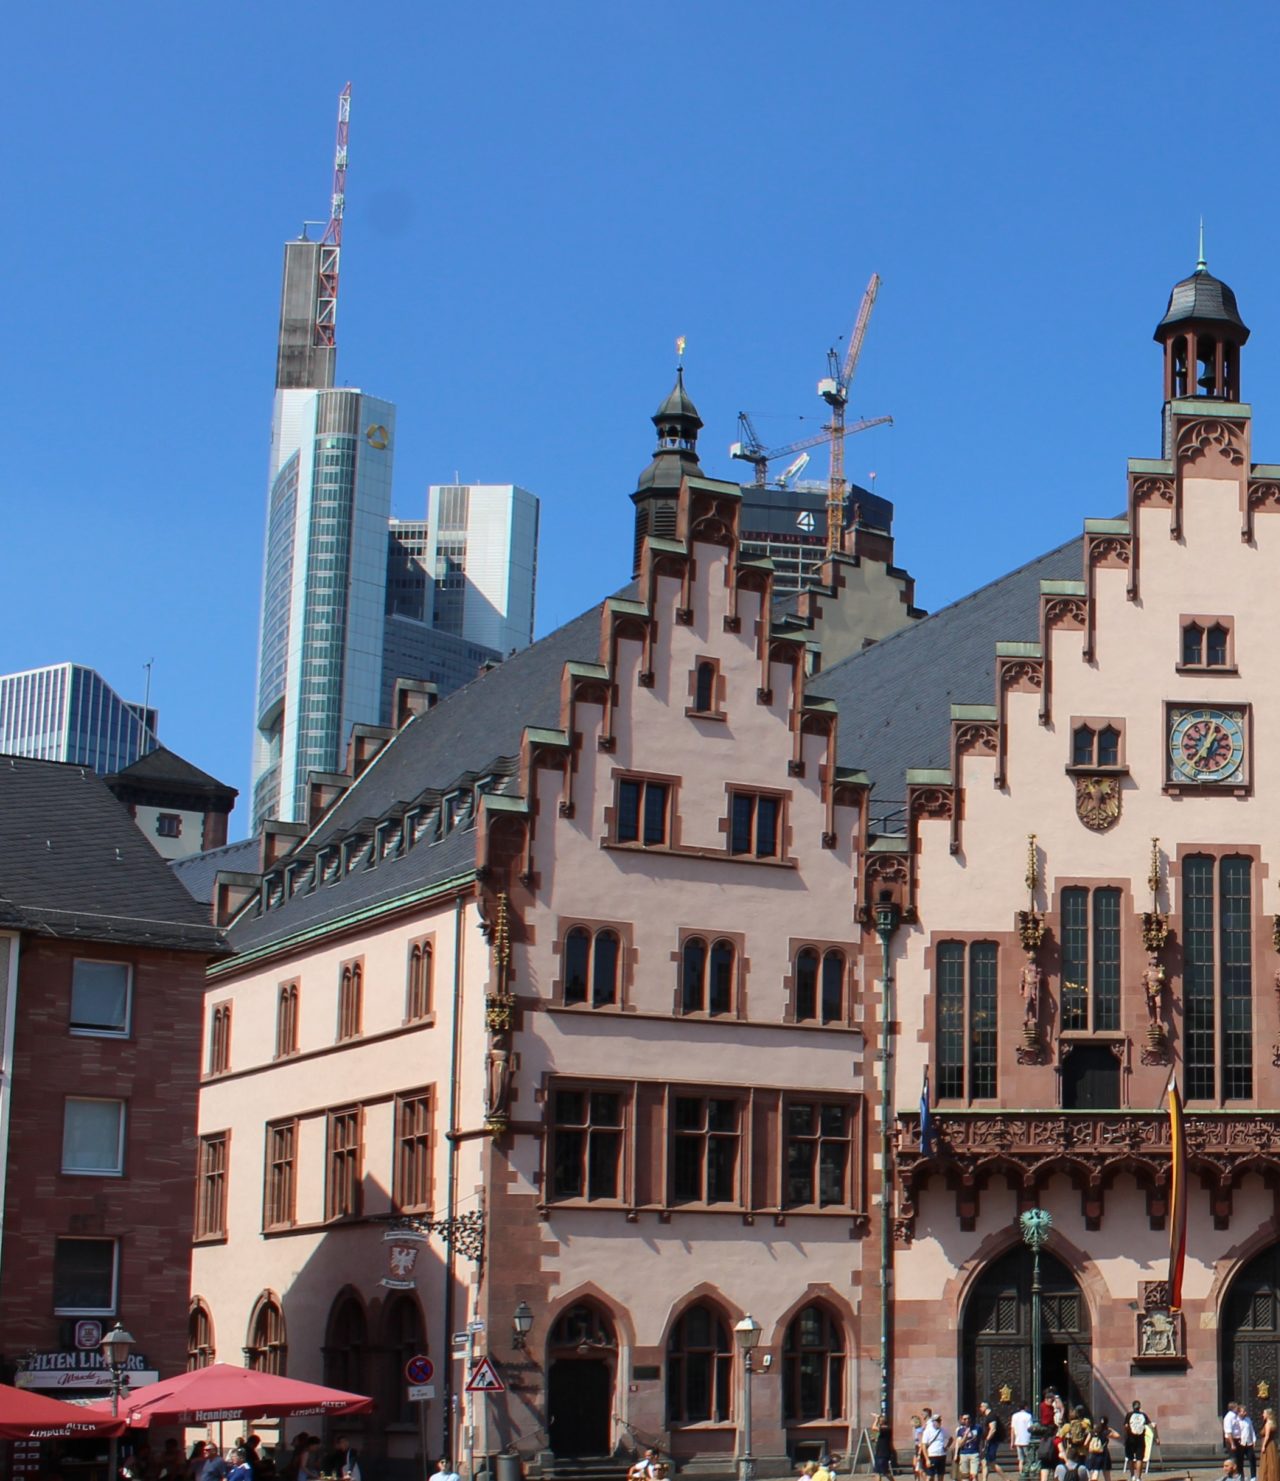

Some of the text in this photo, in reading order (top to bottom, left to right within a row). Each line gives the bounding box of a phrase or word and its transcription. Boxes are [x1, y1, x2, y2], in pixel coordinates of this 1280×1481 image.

[29, 1352, 144, 1370] ALTEN LIMRG
[195, 1408, 243, 1421] Henninger
